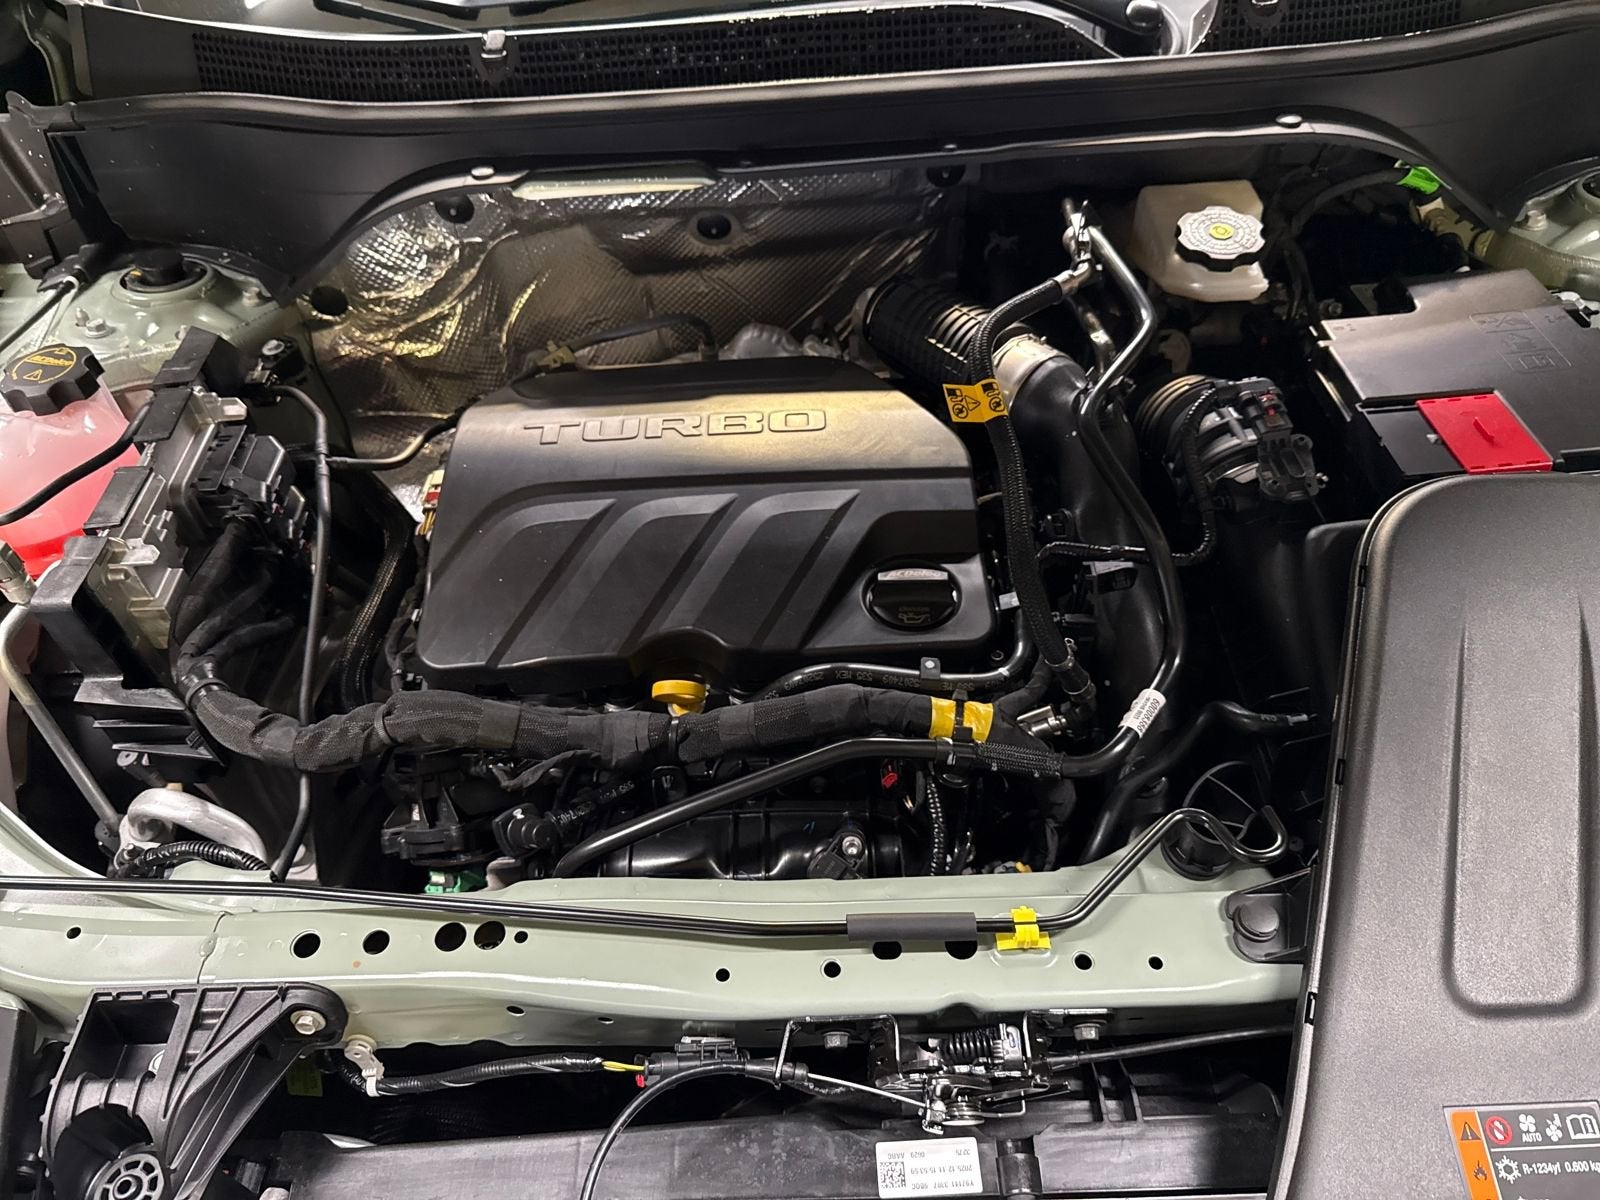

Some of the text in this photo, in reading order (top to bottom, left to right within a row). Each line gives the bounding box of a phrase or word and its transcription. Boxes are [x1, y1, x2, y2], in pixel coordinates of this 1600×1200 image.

[523, 409, 827, 445] TURBO
[1522, 1132, 1542, 1142] AUTO
[1522, 1162, 1561, 1175] R-1234yf
[1565, 1160, 1589, 1172] 0.600
